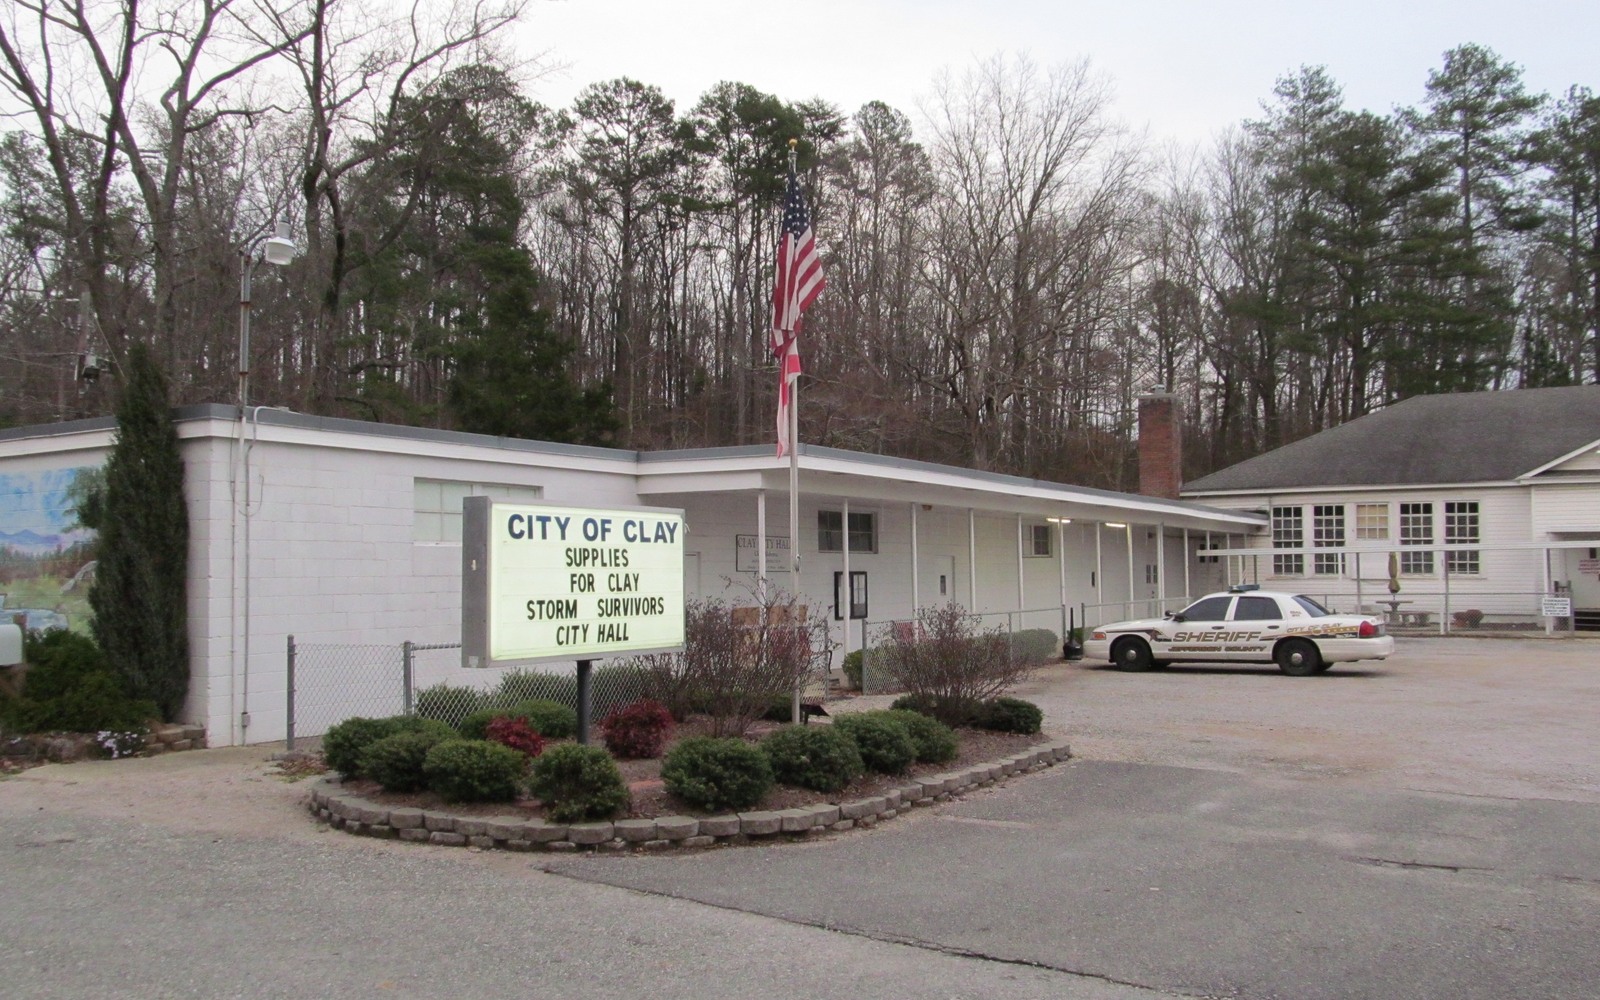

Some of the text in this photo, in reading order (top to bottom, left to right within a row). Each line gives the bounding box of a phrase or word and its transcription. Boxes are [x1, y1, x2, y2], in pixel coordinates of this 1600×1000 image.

[508, 514, 678, 544] CITY OF CLAY
[738, 537, 757, 549] CLAY
[565, 547, 629, 568] SUPPLIES
[570, 573, 640, 593] FOR CLAY
[527, 597, 665, 620] STORM SURVIVORS
[556, 622, 629, 646] CITY HALL
[1173, 631, 1262, 642] SHERIFF
